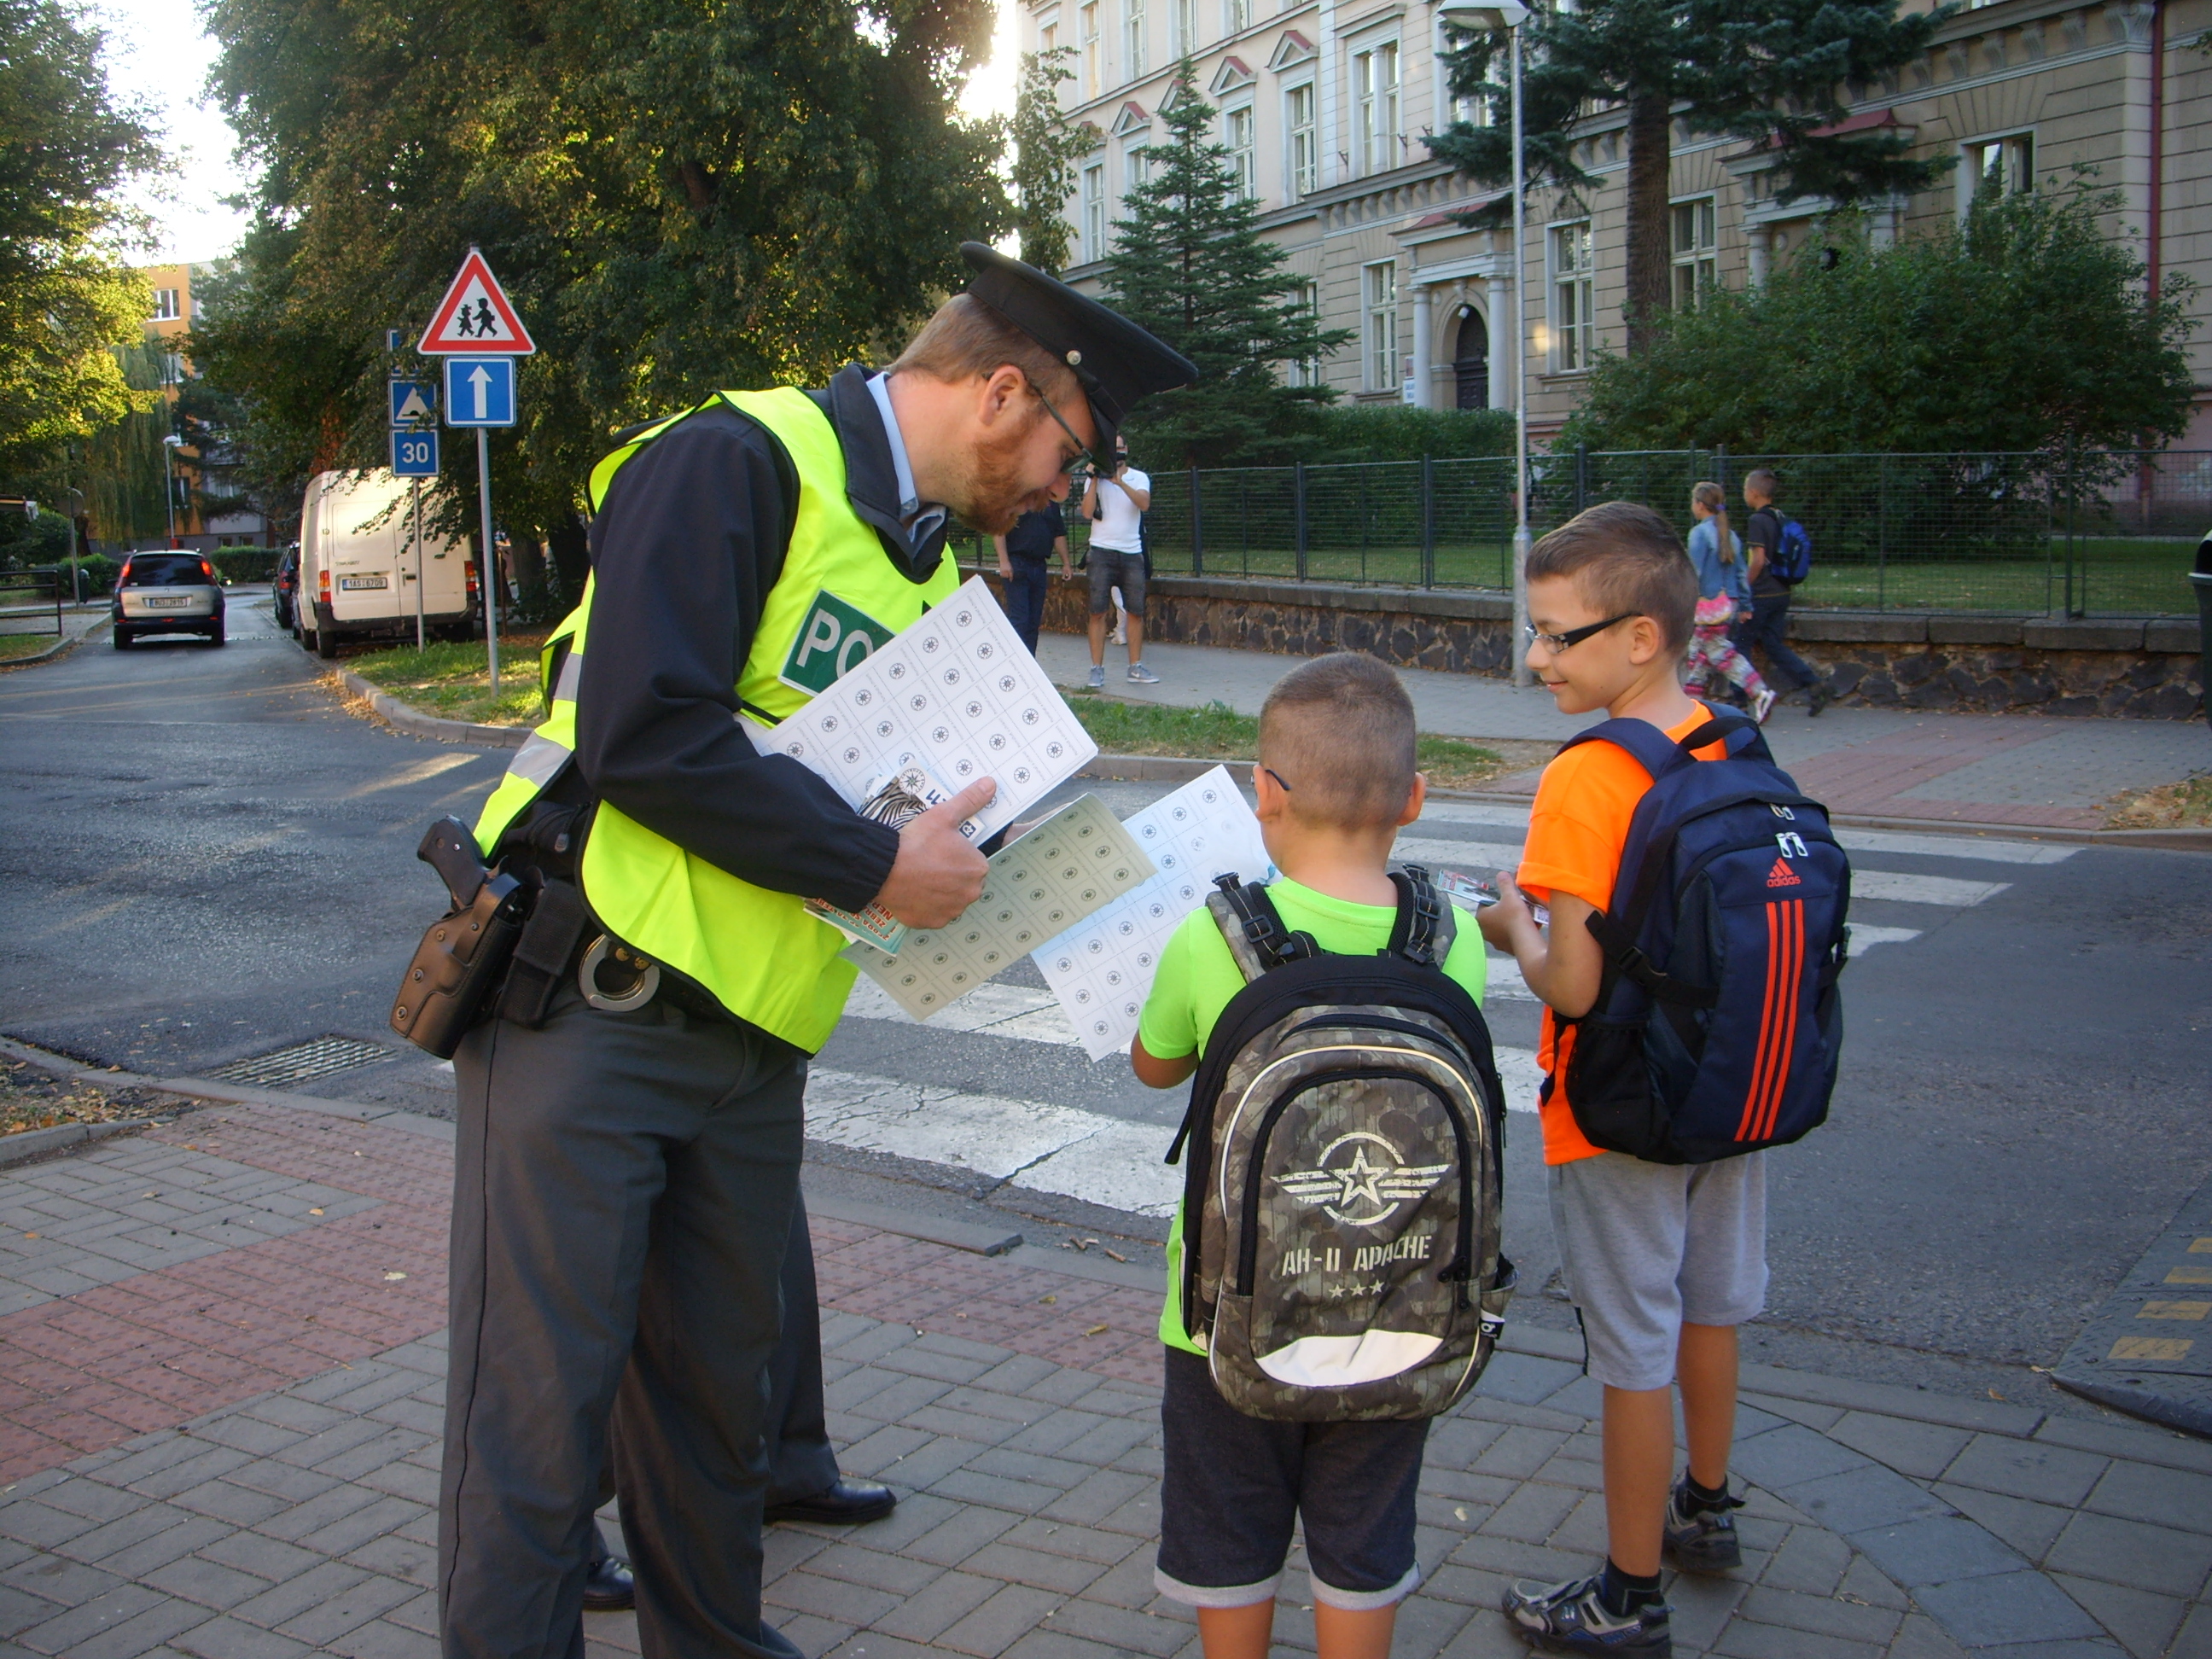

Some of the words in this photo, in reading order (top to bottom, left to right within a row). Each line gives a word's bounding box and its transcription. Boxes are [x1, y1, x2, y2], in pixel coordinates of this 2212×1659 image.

[402, 442, 428, 463] 30
[1767, 876, 1802, 888] adidas
[1353, 1235, 1432, 1272] APACHE
